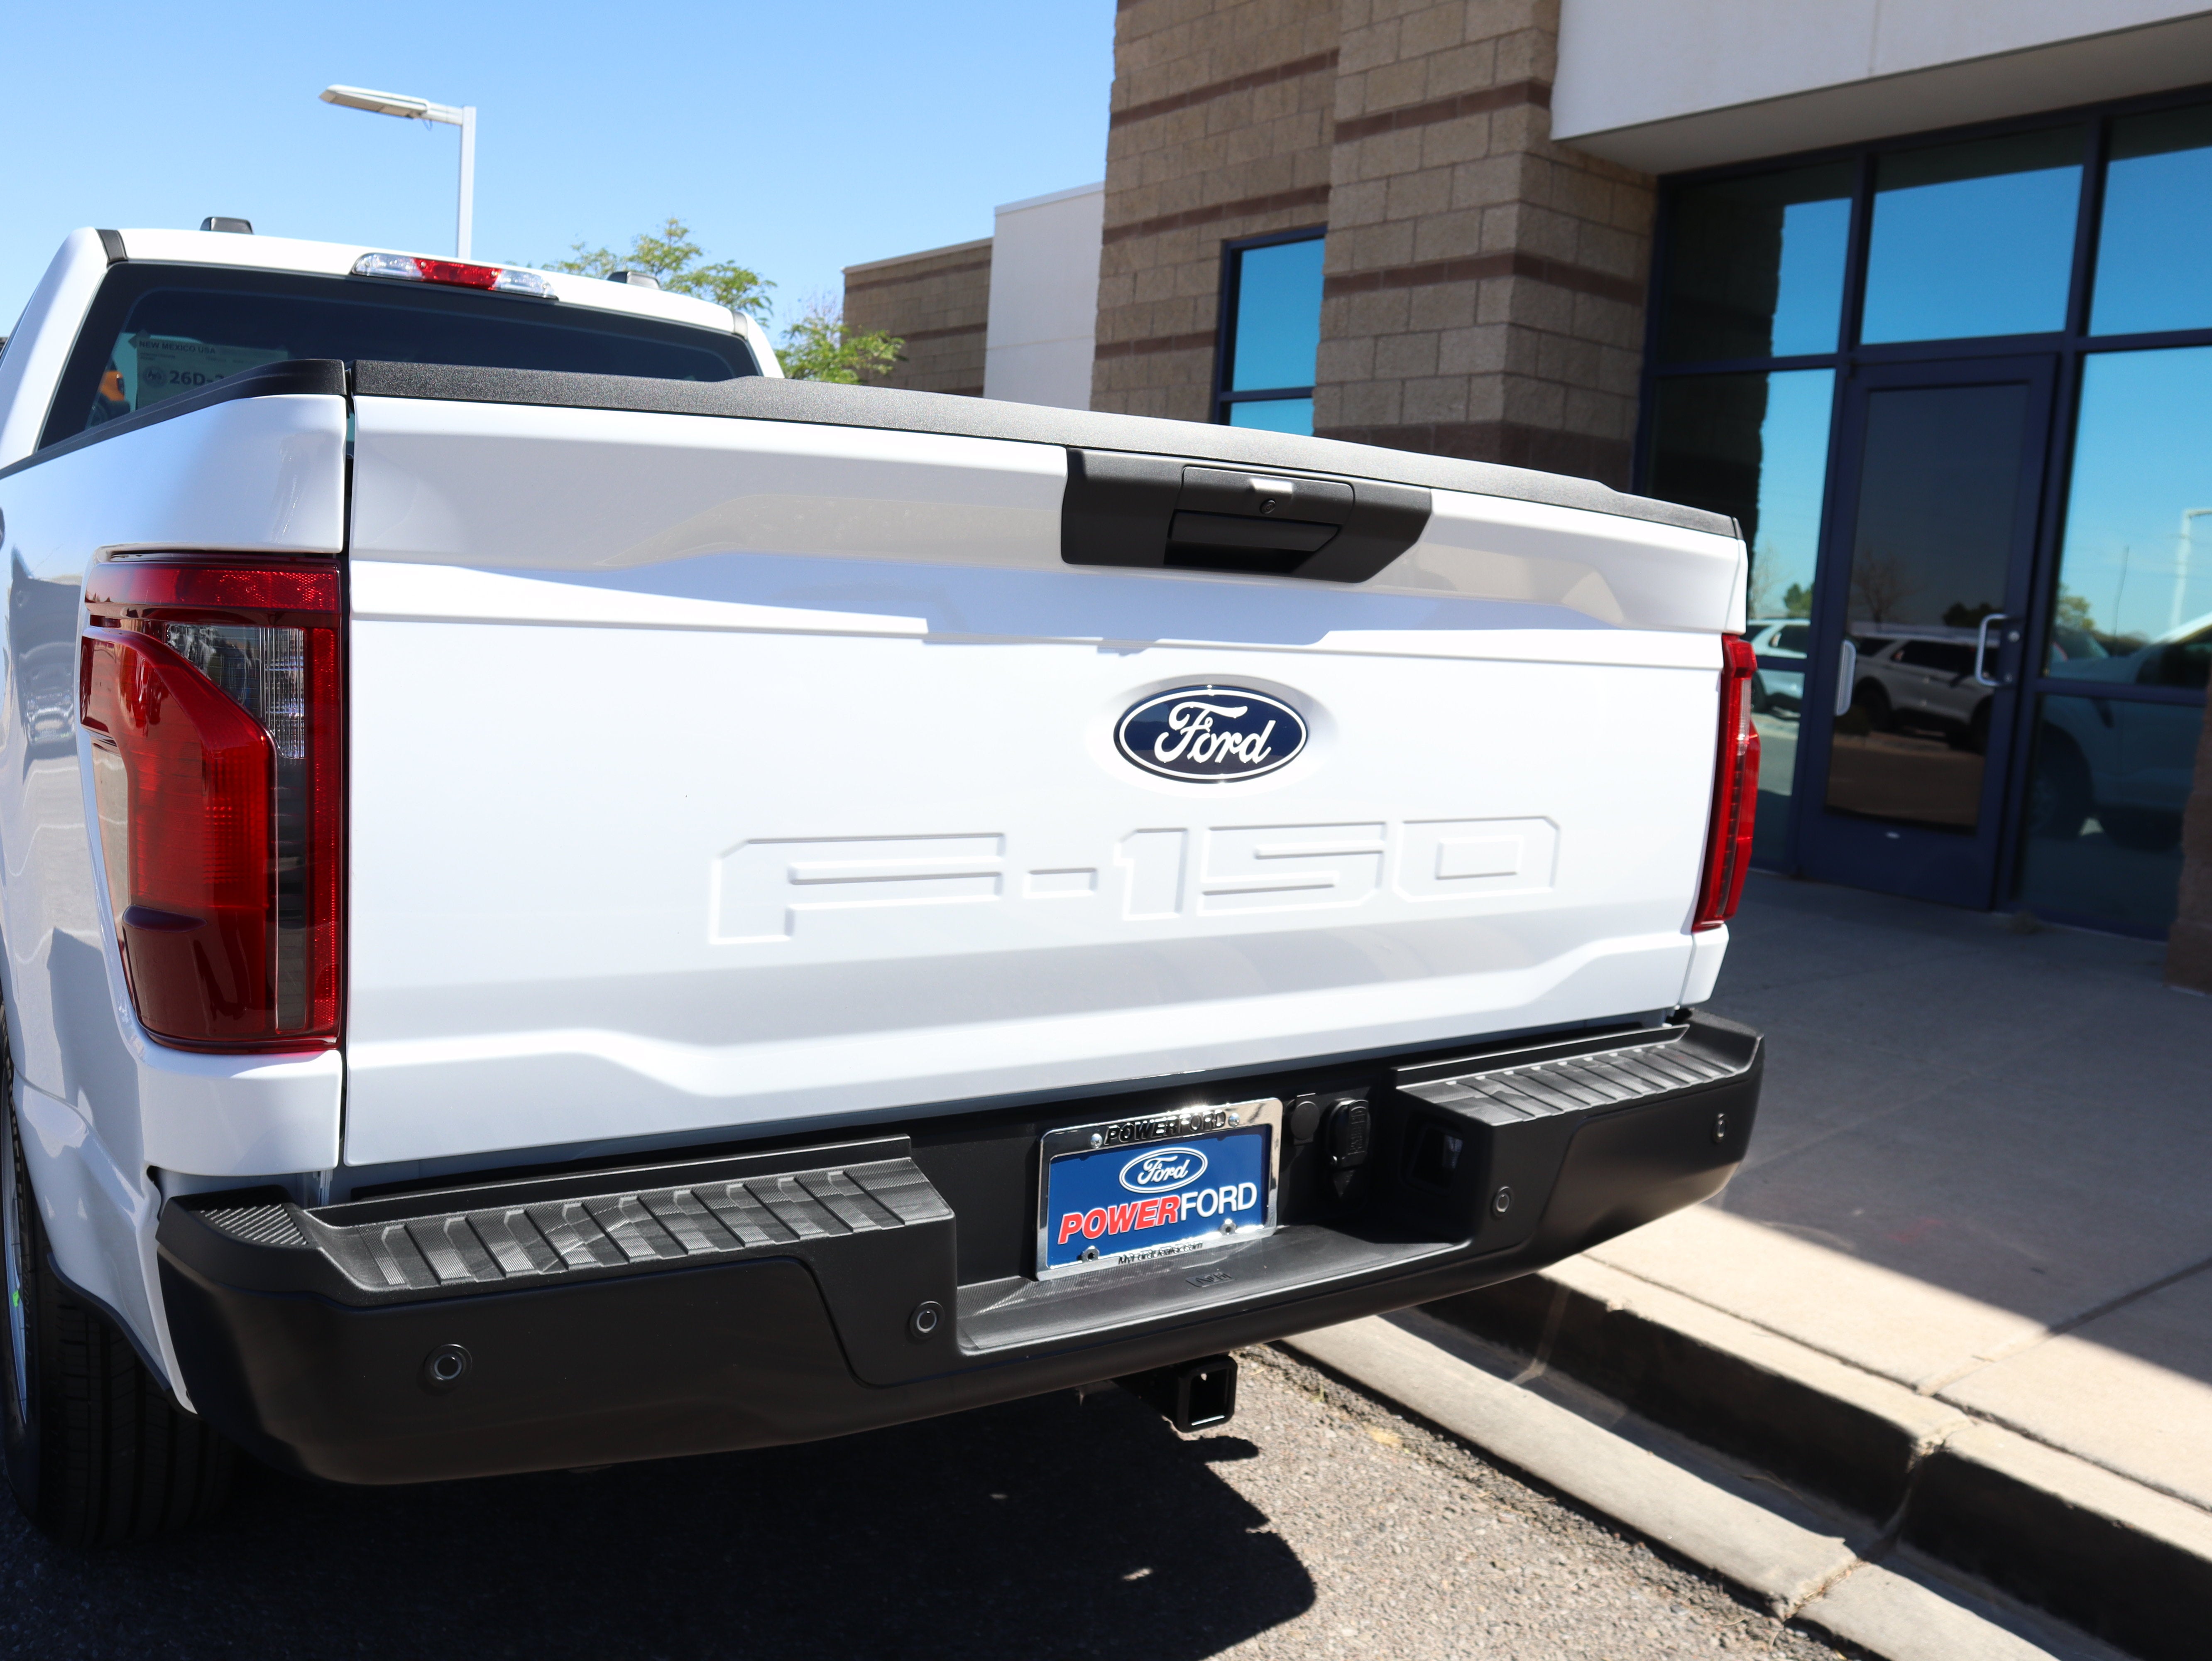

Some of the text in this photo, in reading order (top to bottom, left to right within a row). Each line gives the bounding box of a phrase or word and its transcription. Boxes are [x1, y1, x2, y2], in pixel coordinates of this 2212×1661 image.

[139, 340, 160, 349] NEW
[161, 343, 196, 353] MEXICO
[1154, 701, 1276, 763] Ford
[708, 815, 1561, 947] F-150
[1137, 1155, 1190, 1185] Ford
